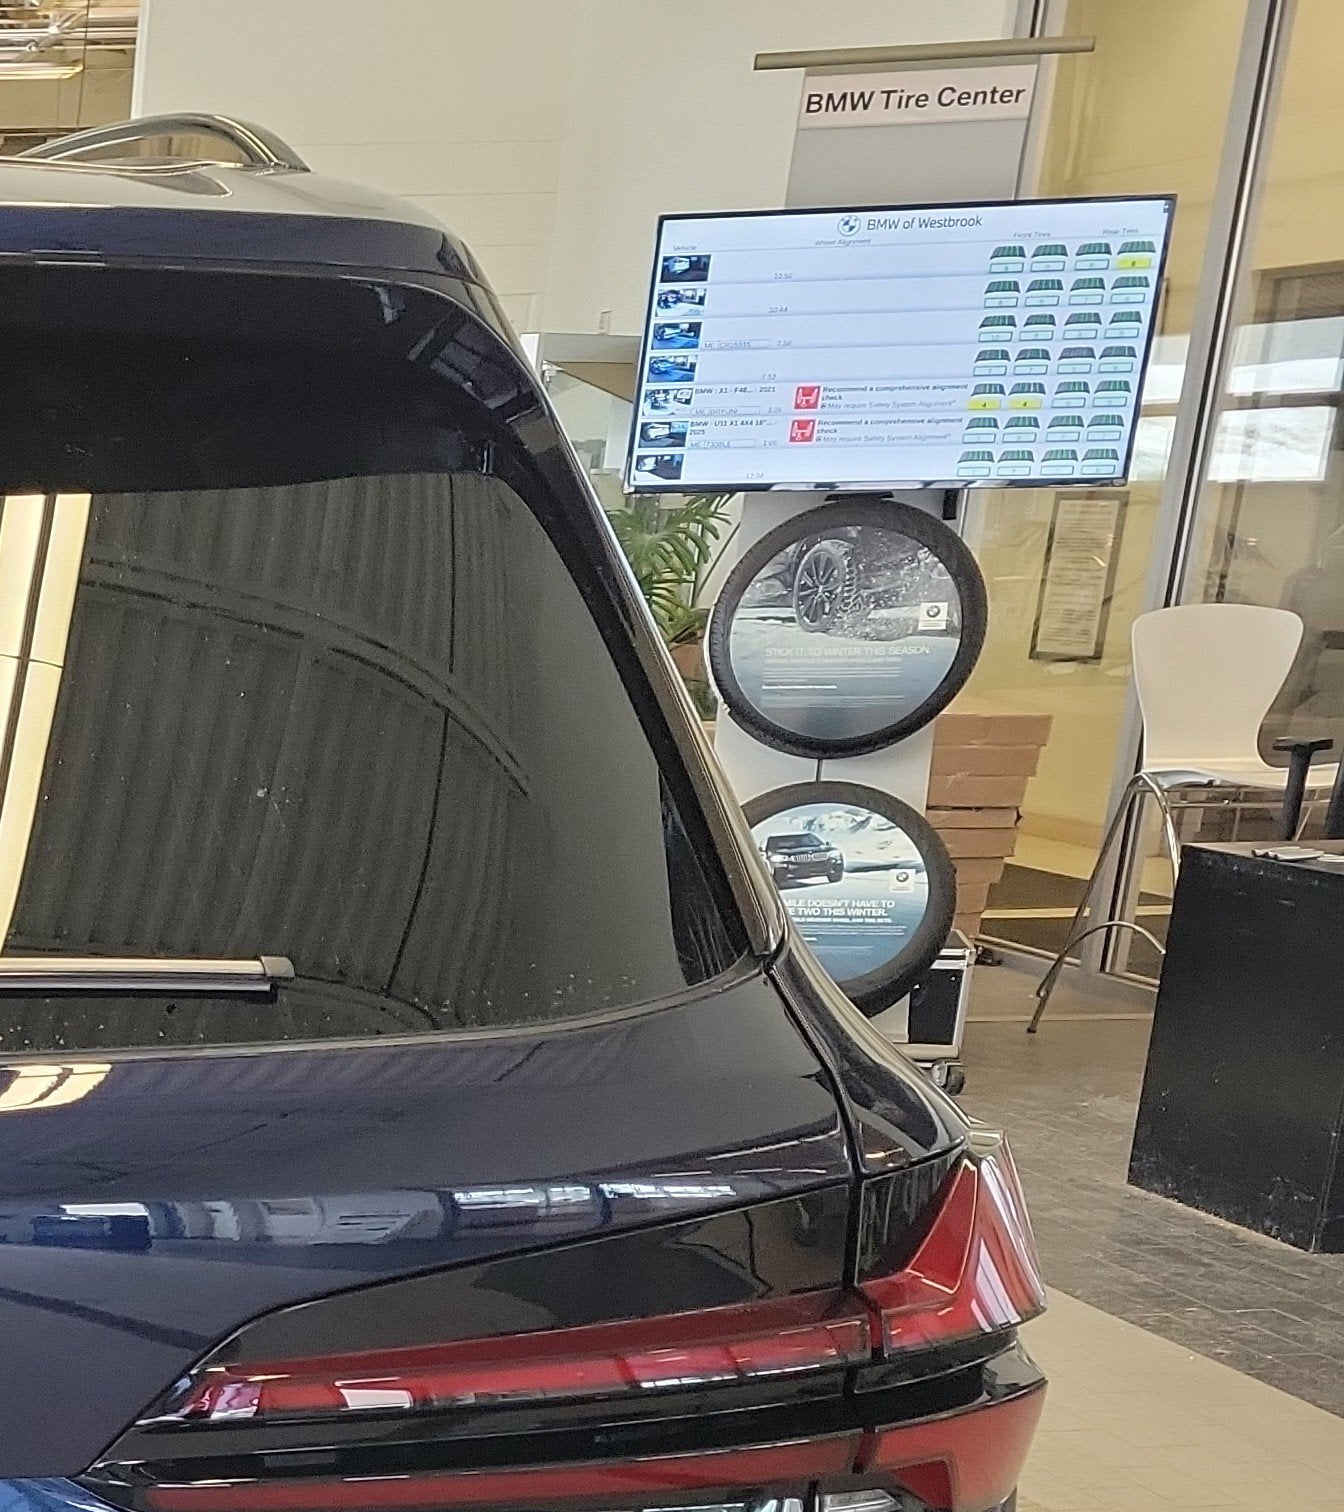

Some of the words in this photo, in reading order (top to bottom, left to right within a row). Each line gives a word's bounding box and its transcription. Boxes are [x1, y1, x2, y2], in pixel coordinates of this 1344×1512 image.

[805, 90, 876, 114] BMW
[880, 88, 930, 110] Tire
[937, 86, 1027, 107] Center
[867, 218, 901, 231] BMW
[903, 217, 915, 230] of
[918, 215, 984, 229] Westbrook
[694, 387, 713, 395] BMW
[823, 385, 867, 393] Recommend
[875, 384, 930, 392] comprehensive
[932, 383, 969, 392] alignment
[690, 420, 709, 428] BMW
[870, 418, 926, 426] comprehensive
[927, 417, 963, 426] alignment
[765, 647, 793, 657] STICK
[824, 647, 862, 656] WINTER
[863, 646, 885, 655] THIS
[807, 899, 849, 907] DOESN'T
[851, 899, 879, 907] HAVE
[881, 900, 896, 908] TO
[797, 907, 821, 916] TWO
[822, 907, 846, 916] THIS
